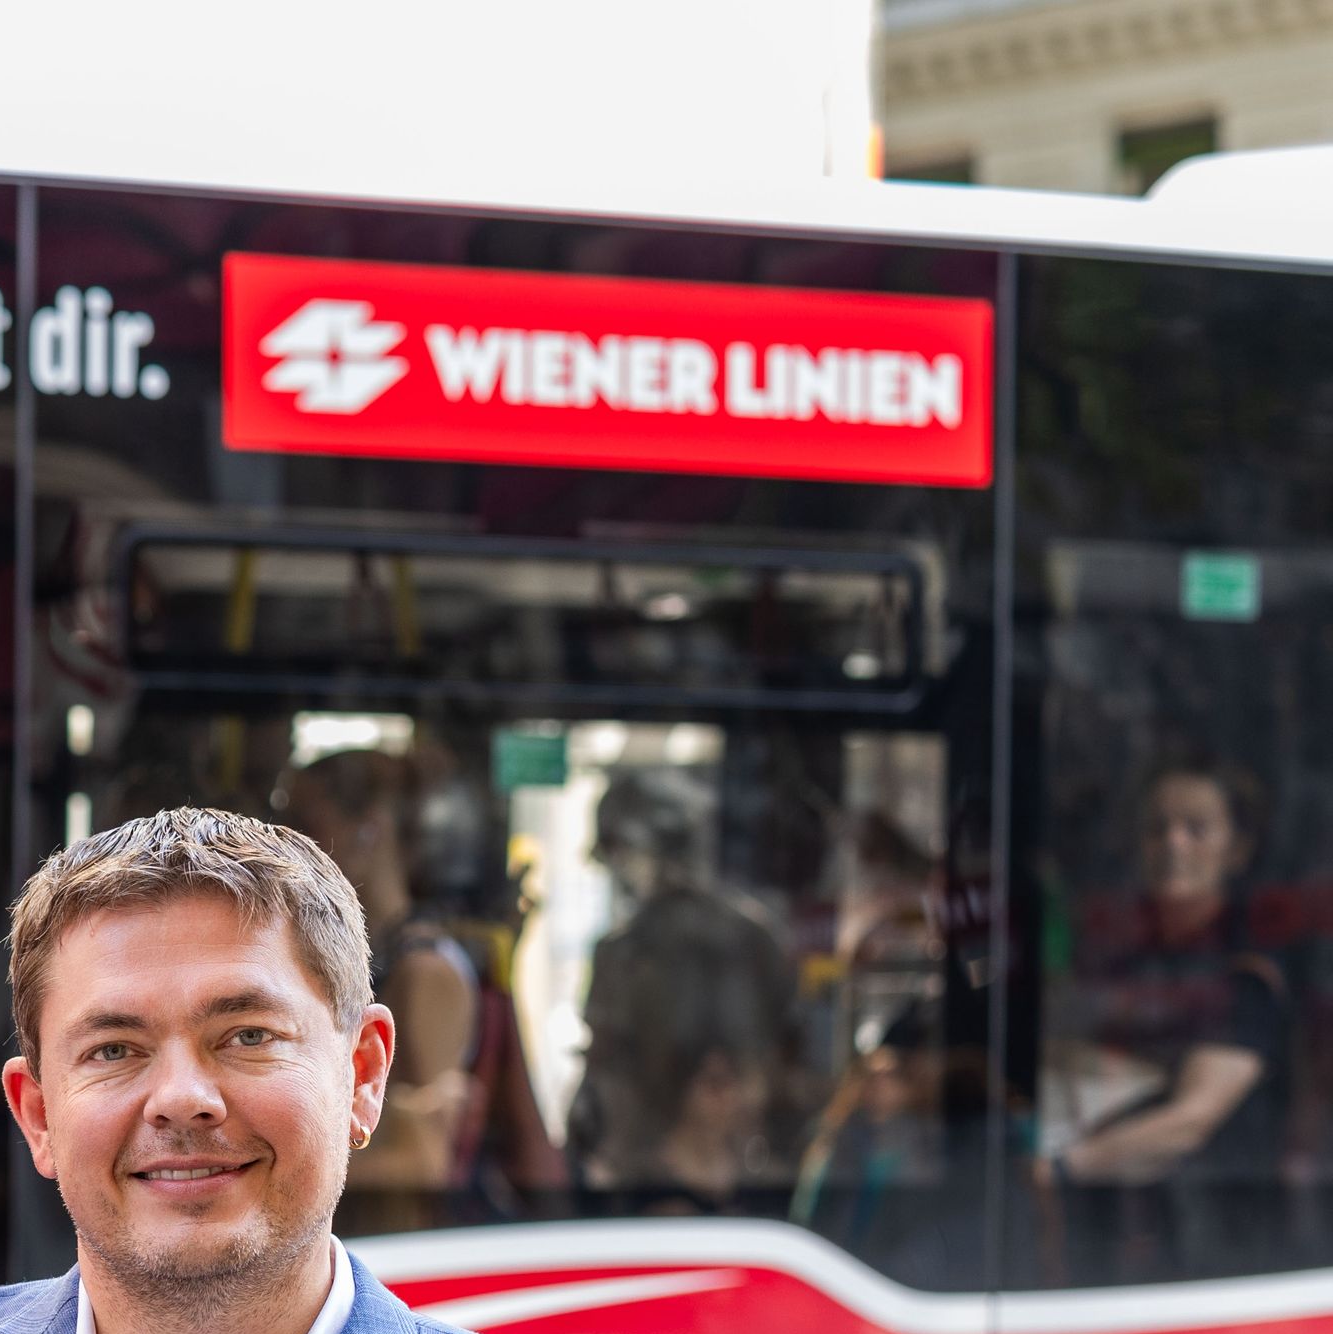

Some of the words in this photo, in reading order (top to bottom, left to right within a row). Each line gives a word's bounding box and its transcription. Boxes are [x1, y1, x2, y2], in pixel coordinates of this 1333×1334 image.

[29, 285, 172, 401] dir.
[425, 323, 718, 416] WIENER
[730, 341, 963, 431] LINIEN
